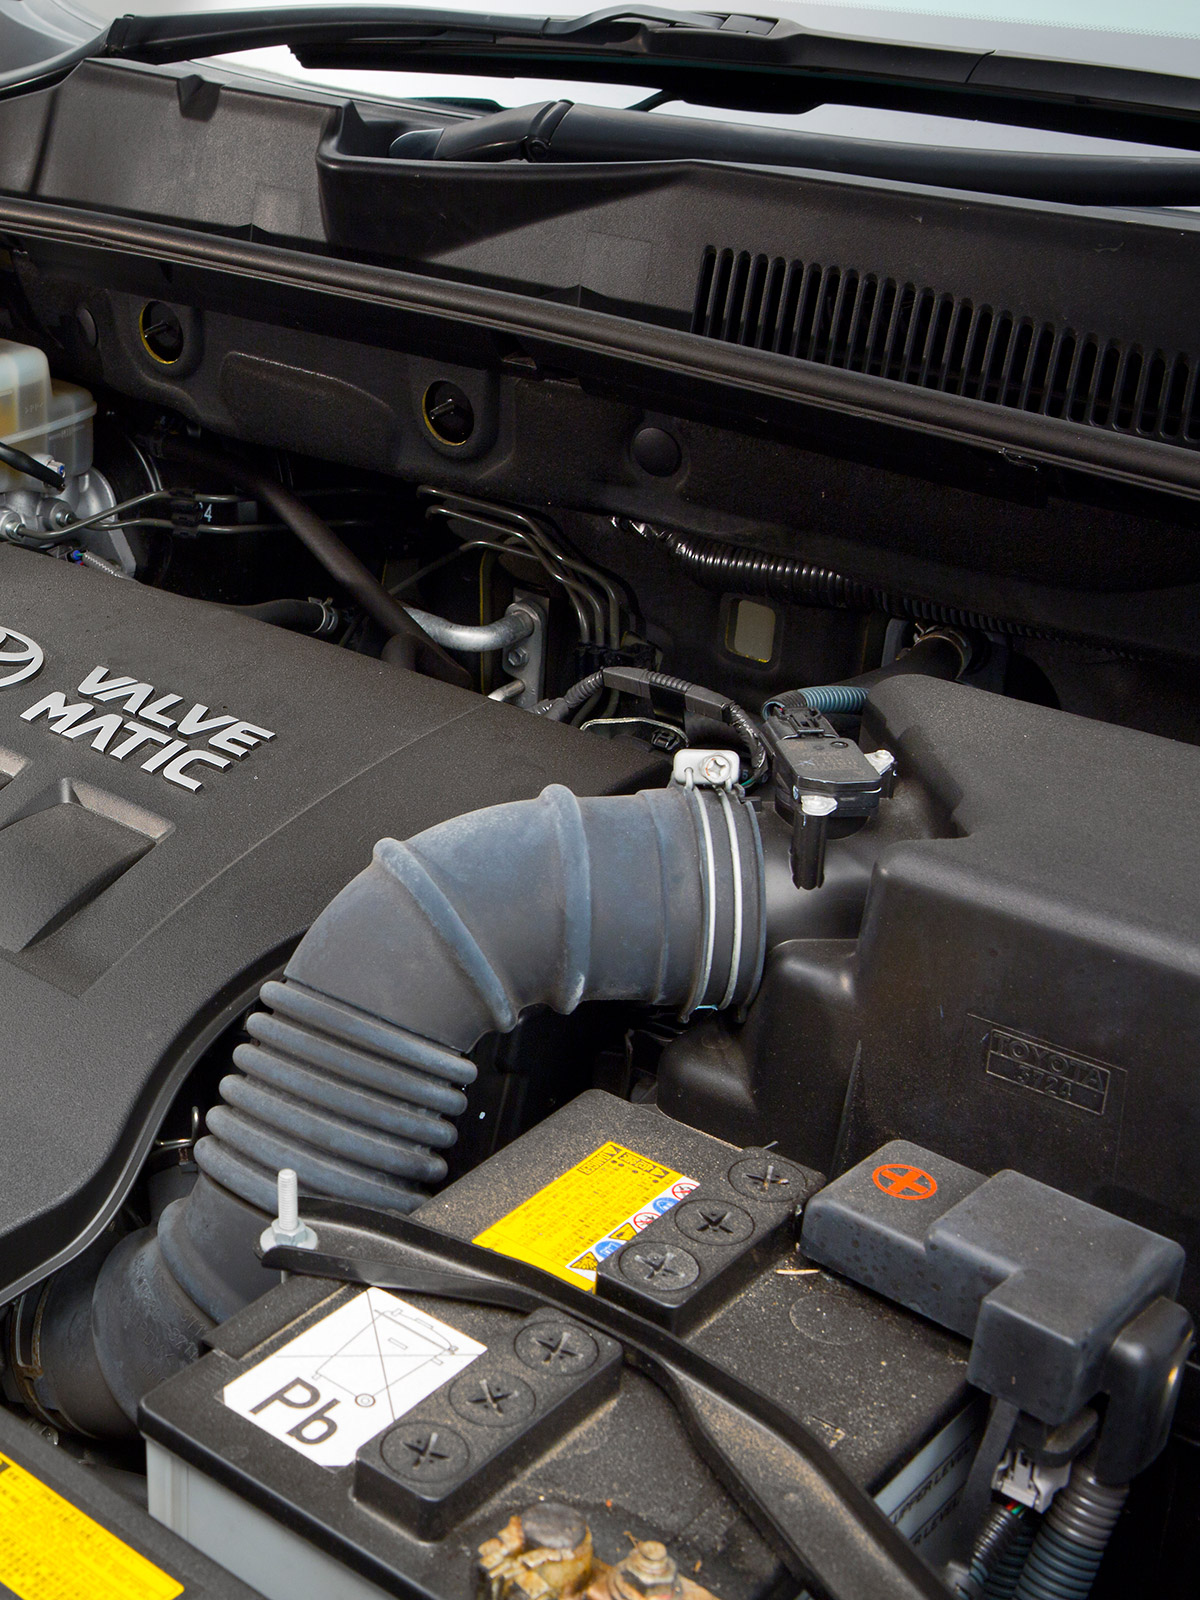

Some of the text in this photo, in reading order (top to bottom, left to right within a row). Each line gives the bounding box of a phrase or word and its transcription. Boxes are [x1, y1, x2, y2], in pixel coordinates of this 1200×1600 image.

[19, 691, 232, 794] MATIC
[77, 665, 277, 761] VALVE
[993, 1033, 1105, 1092] TOYOTA
[249, 1377, 341, 1445] Pb
